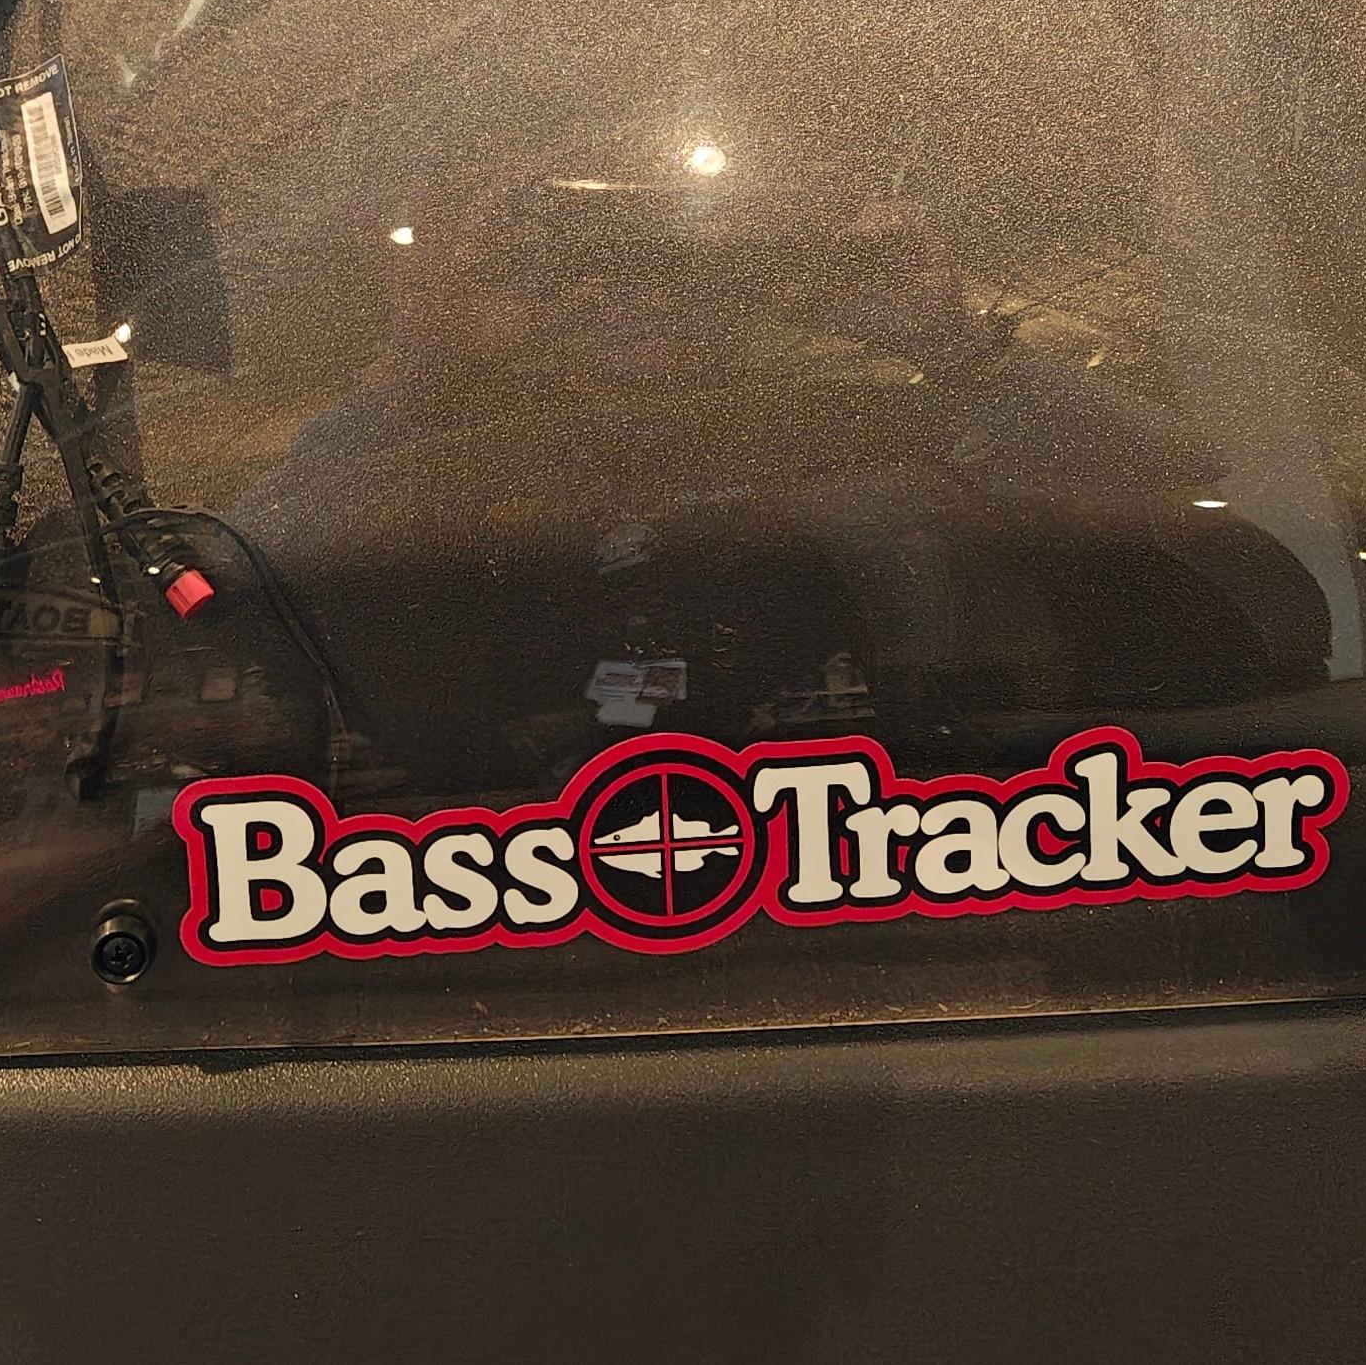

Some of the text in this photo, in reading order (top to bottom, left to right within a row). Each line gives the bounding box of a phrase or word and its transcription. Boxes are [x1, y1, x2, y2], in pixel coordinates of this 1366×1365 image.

[15, 63, 60, 94] REMOVE
[57, 237, 75, 256] NOT
[6, 249, 57, 273] REMOVE
[74, 344, 114, 358] Made
[200, 751, 1325, 943] Bass Tracker
